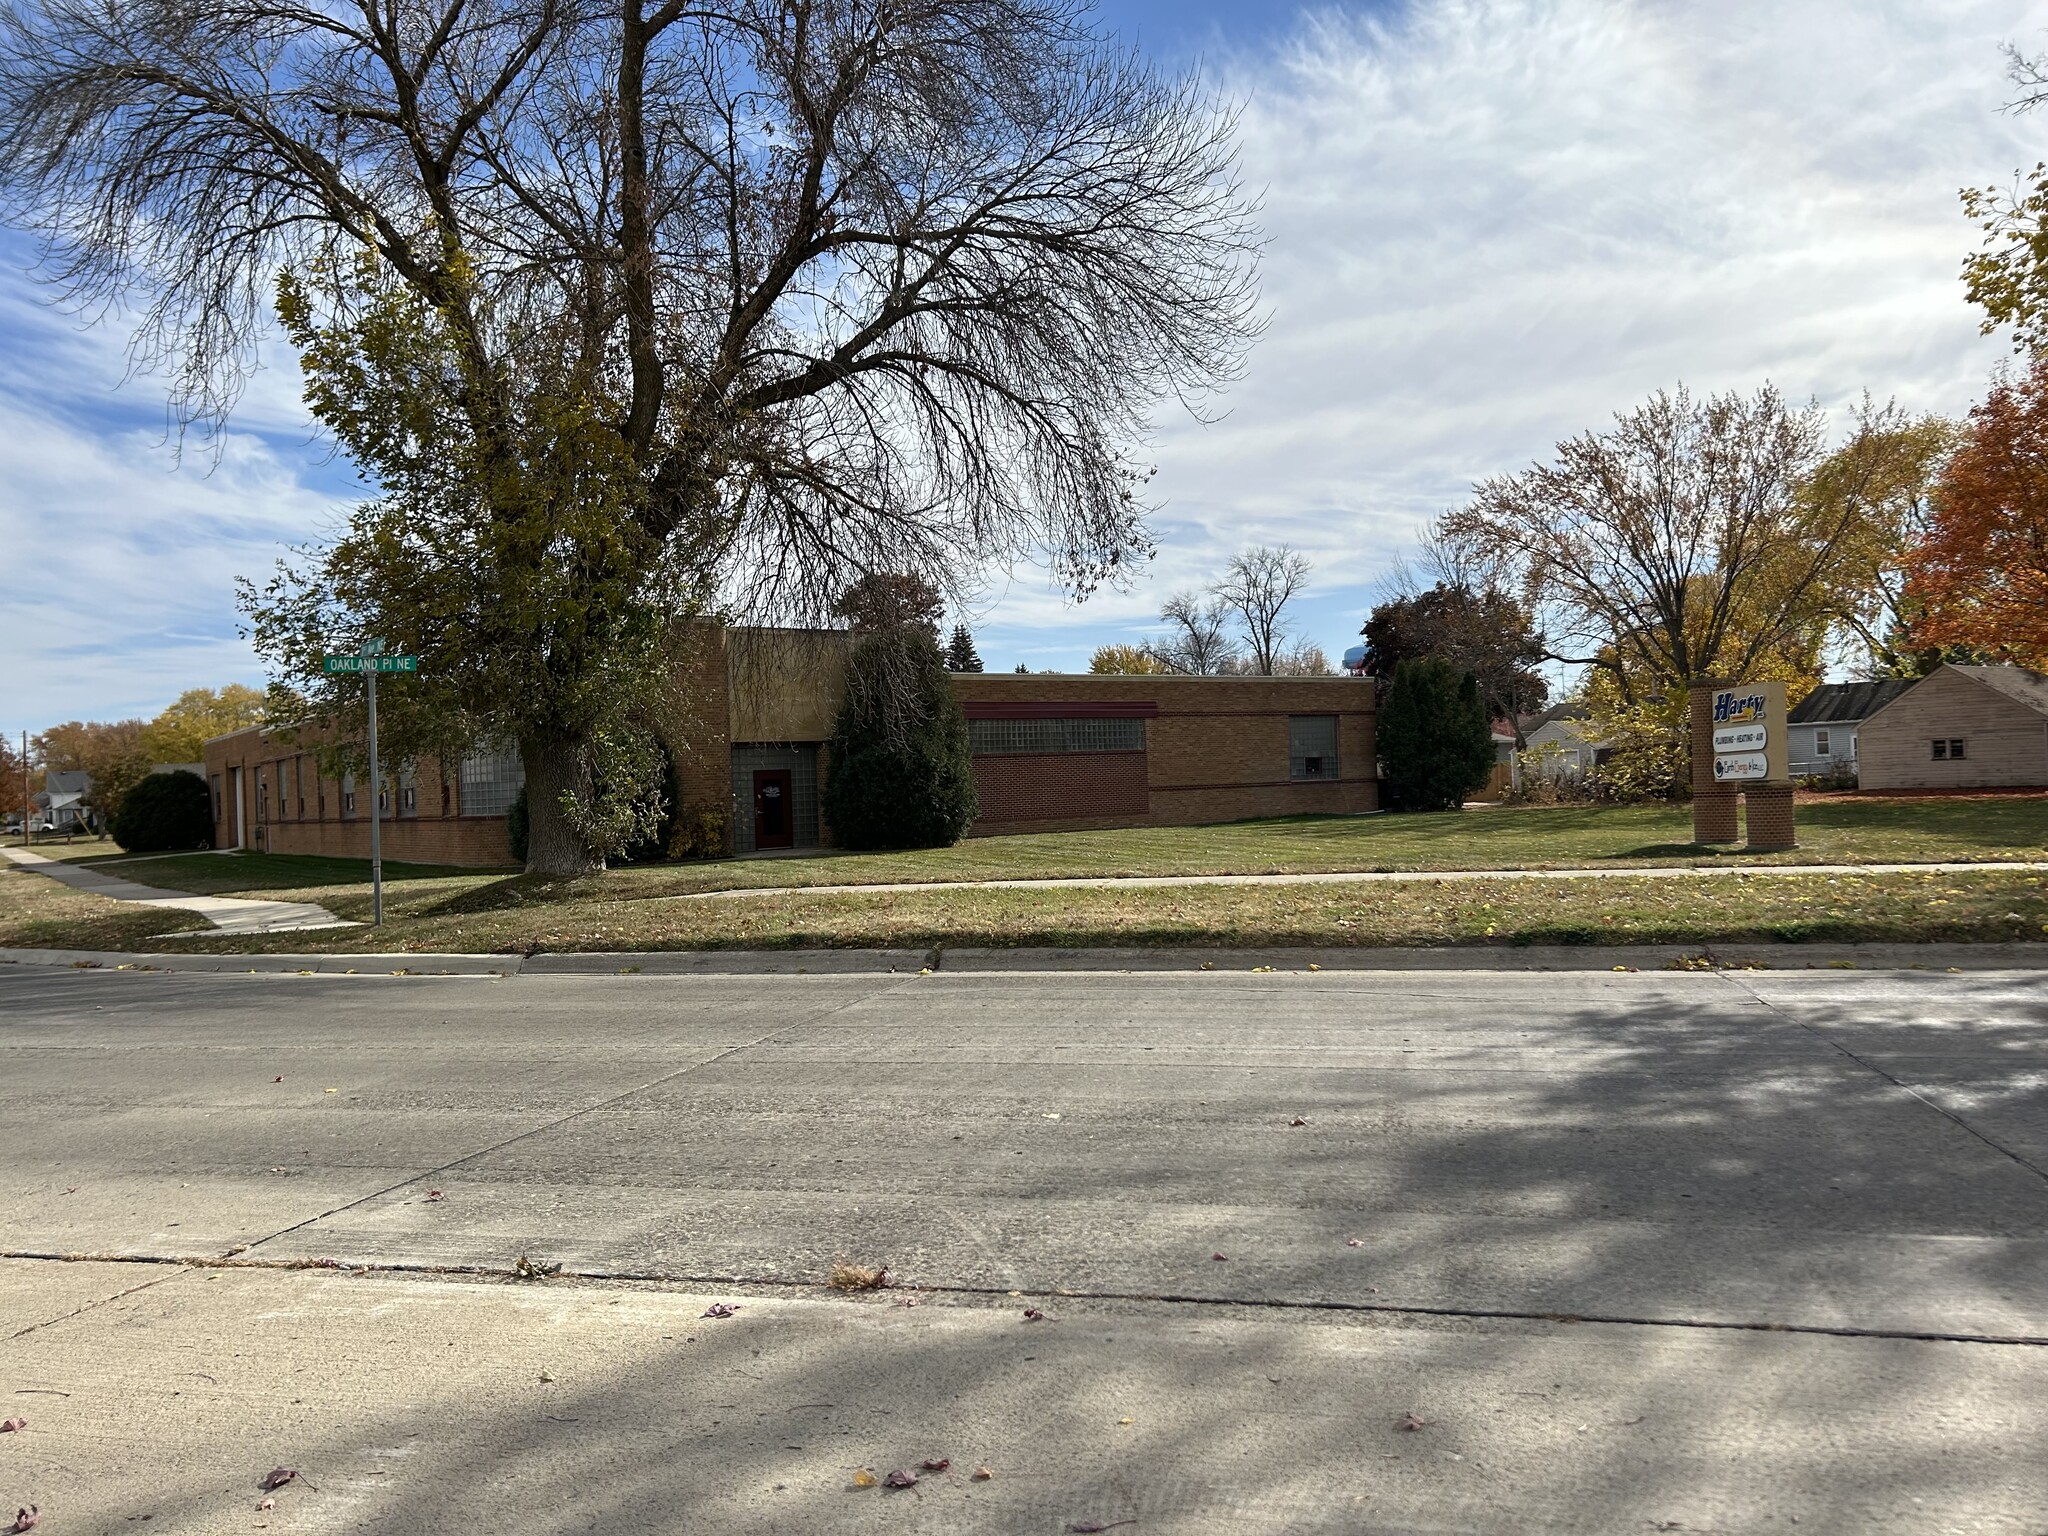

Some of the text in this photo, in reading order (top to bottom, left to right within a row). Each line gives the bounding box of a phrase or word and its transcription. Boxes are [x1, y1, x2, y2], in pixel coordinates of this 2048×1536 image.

[330, 659, 378, 671] OAKLAND
[396, 658, 411, 670] NE
[1713, 691, 1764, 722] Harty
[1736, 733, 1753, 743] HEATING
[1756, 732, 1764, 741] AIR
